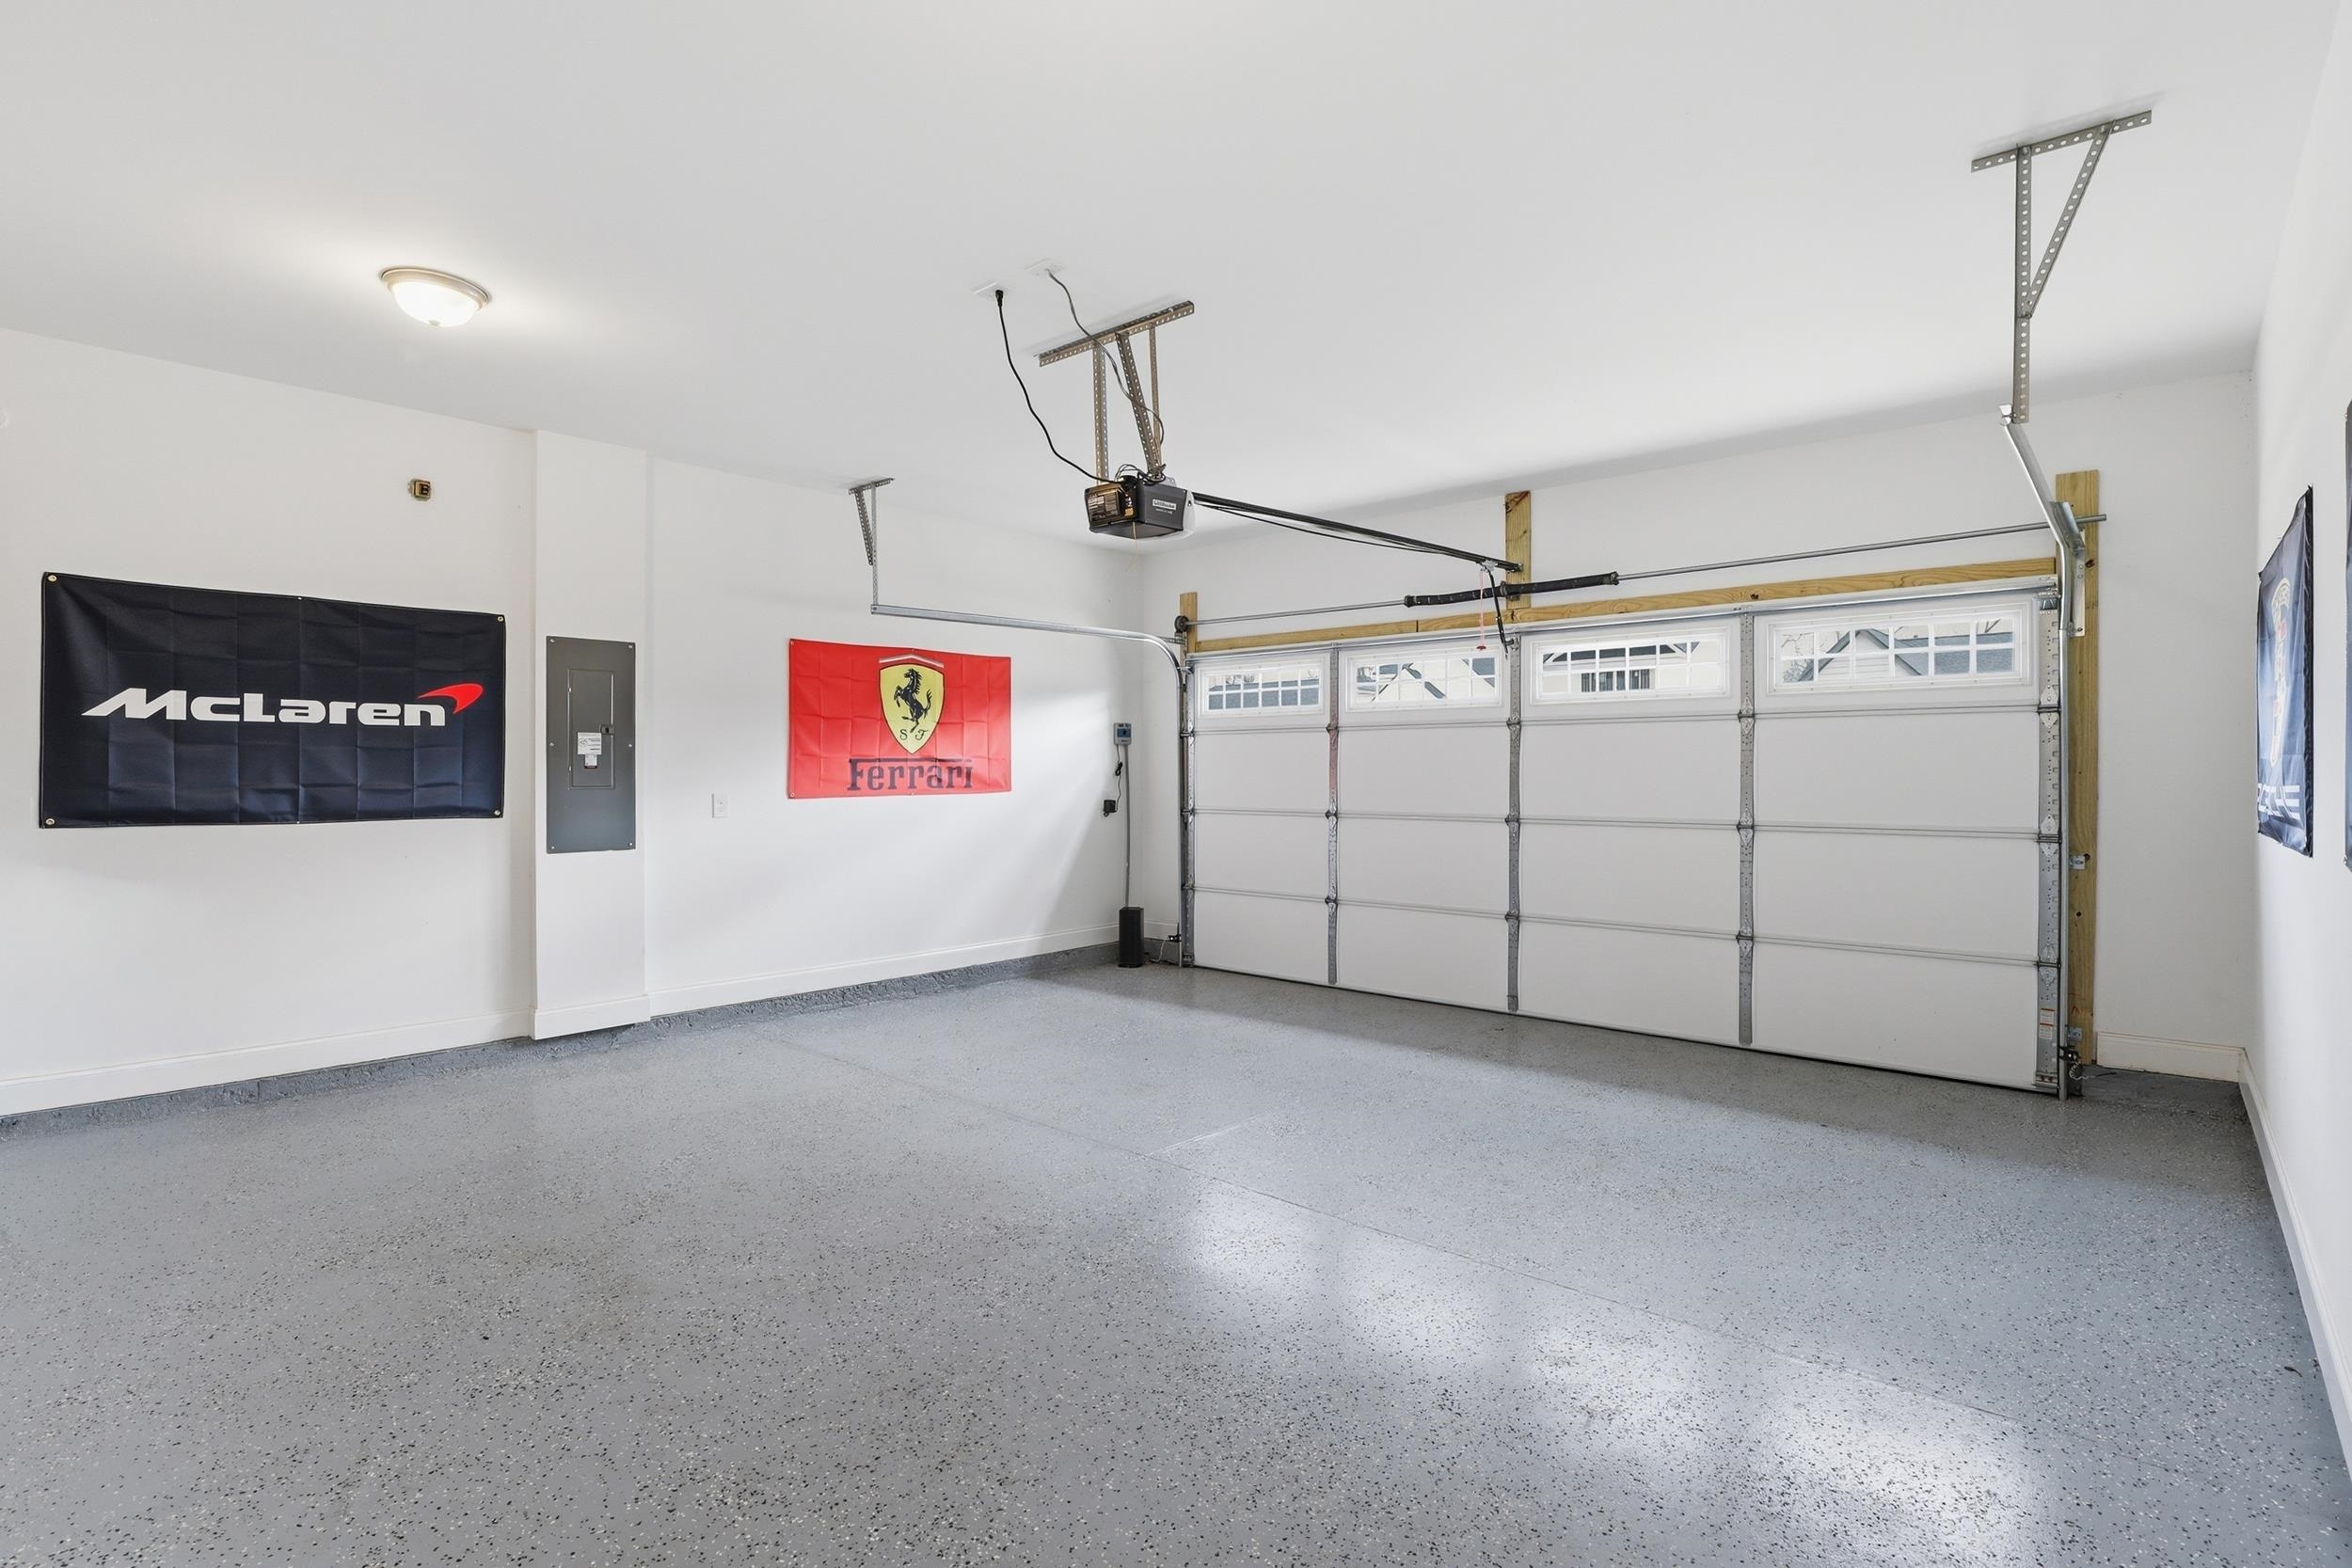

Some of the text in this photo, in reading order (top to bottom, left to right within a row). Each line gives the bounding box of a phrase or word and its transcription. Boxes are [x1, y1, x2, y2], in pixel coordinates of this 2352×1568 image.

[81, 687, 446, 727] McLaren
[899, 729, 930, 740] S F
[848, 757, 973, 791] Ferrari
